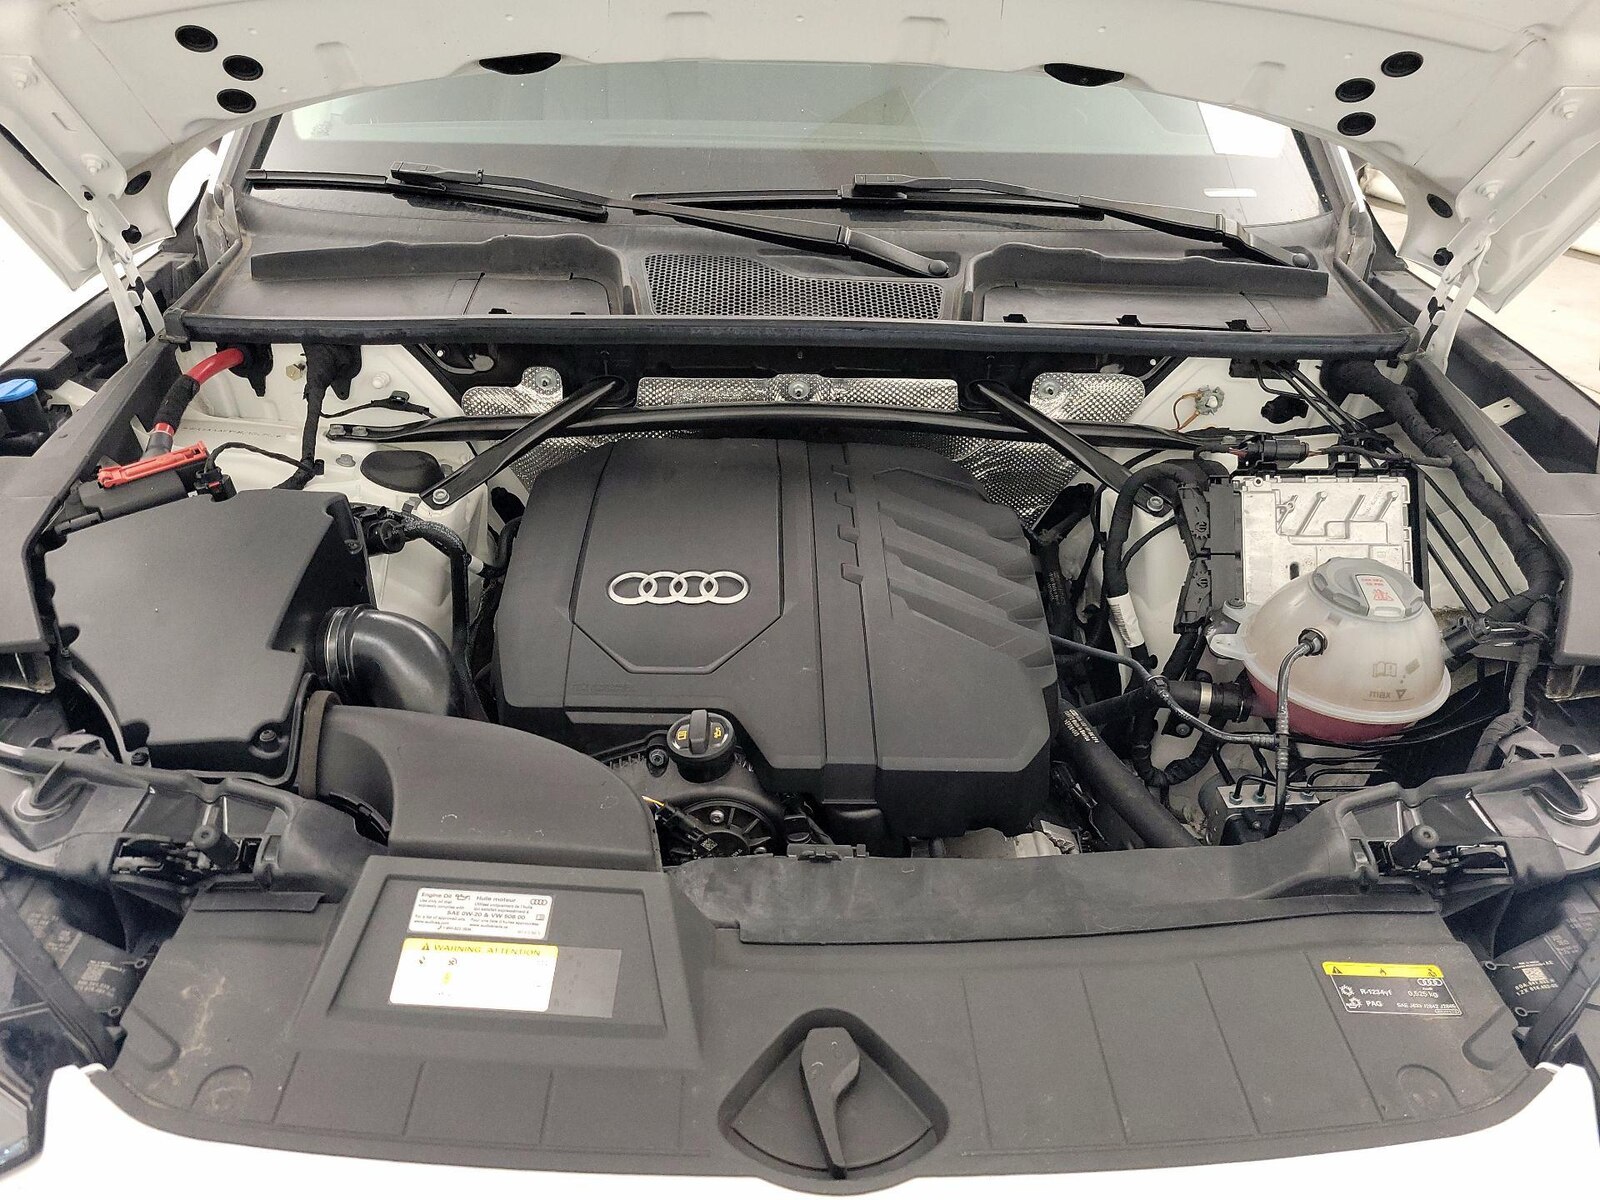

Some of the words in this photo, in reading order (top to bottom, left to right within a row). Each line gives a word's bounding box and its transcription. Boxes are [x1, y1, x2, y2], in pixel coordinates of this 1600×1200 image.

[1369, 691, 1391, 699] max
[434, 944, 481, 953] WARNING
[486, 947, 541, 956] ATTENTION
